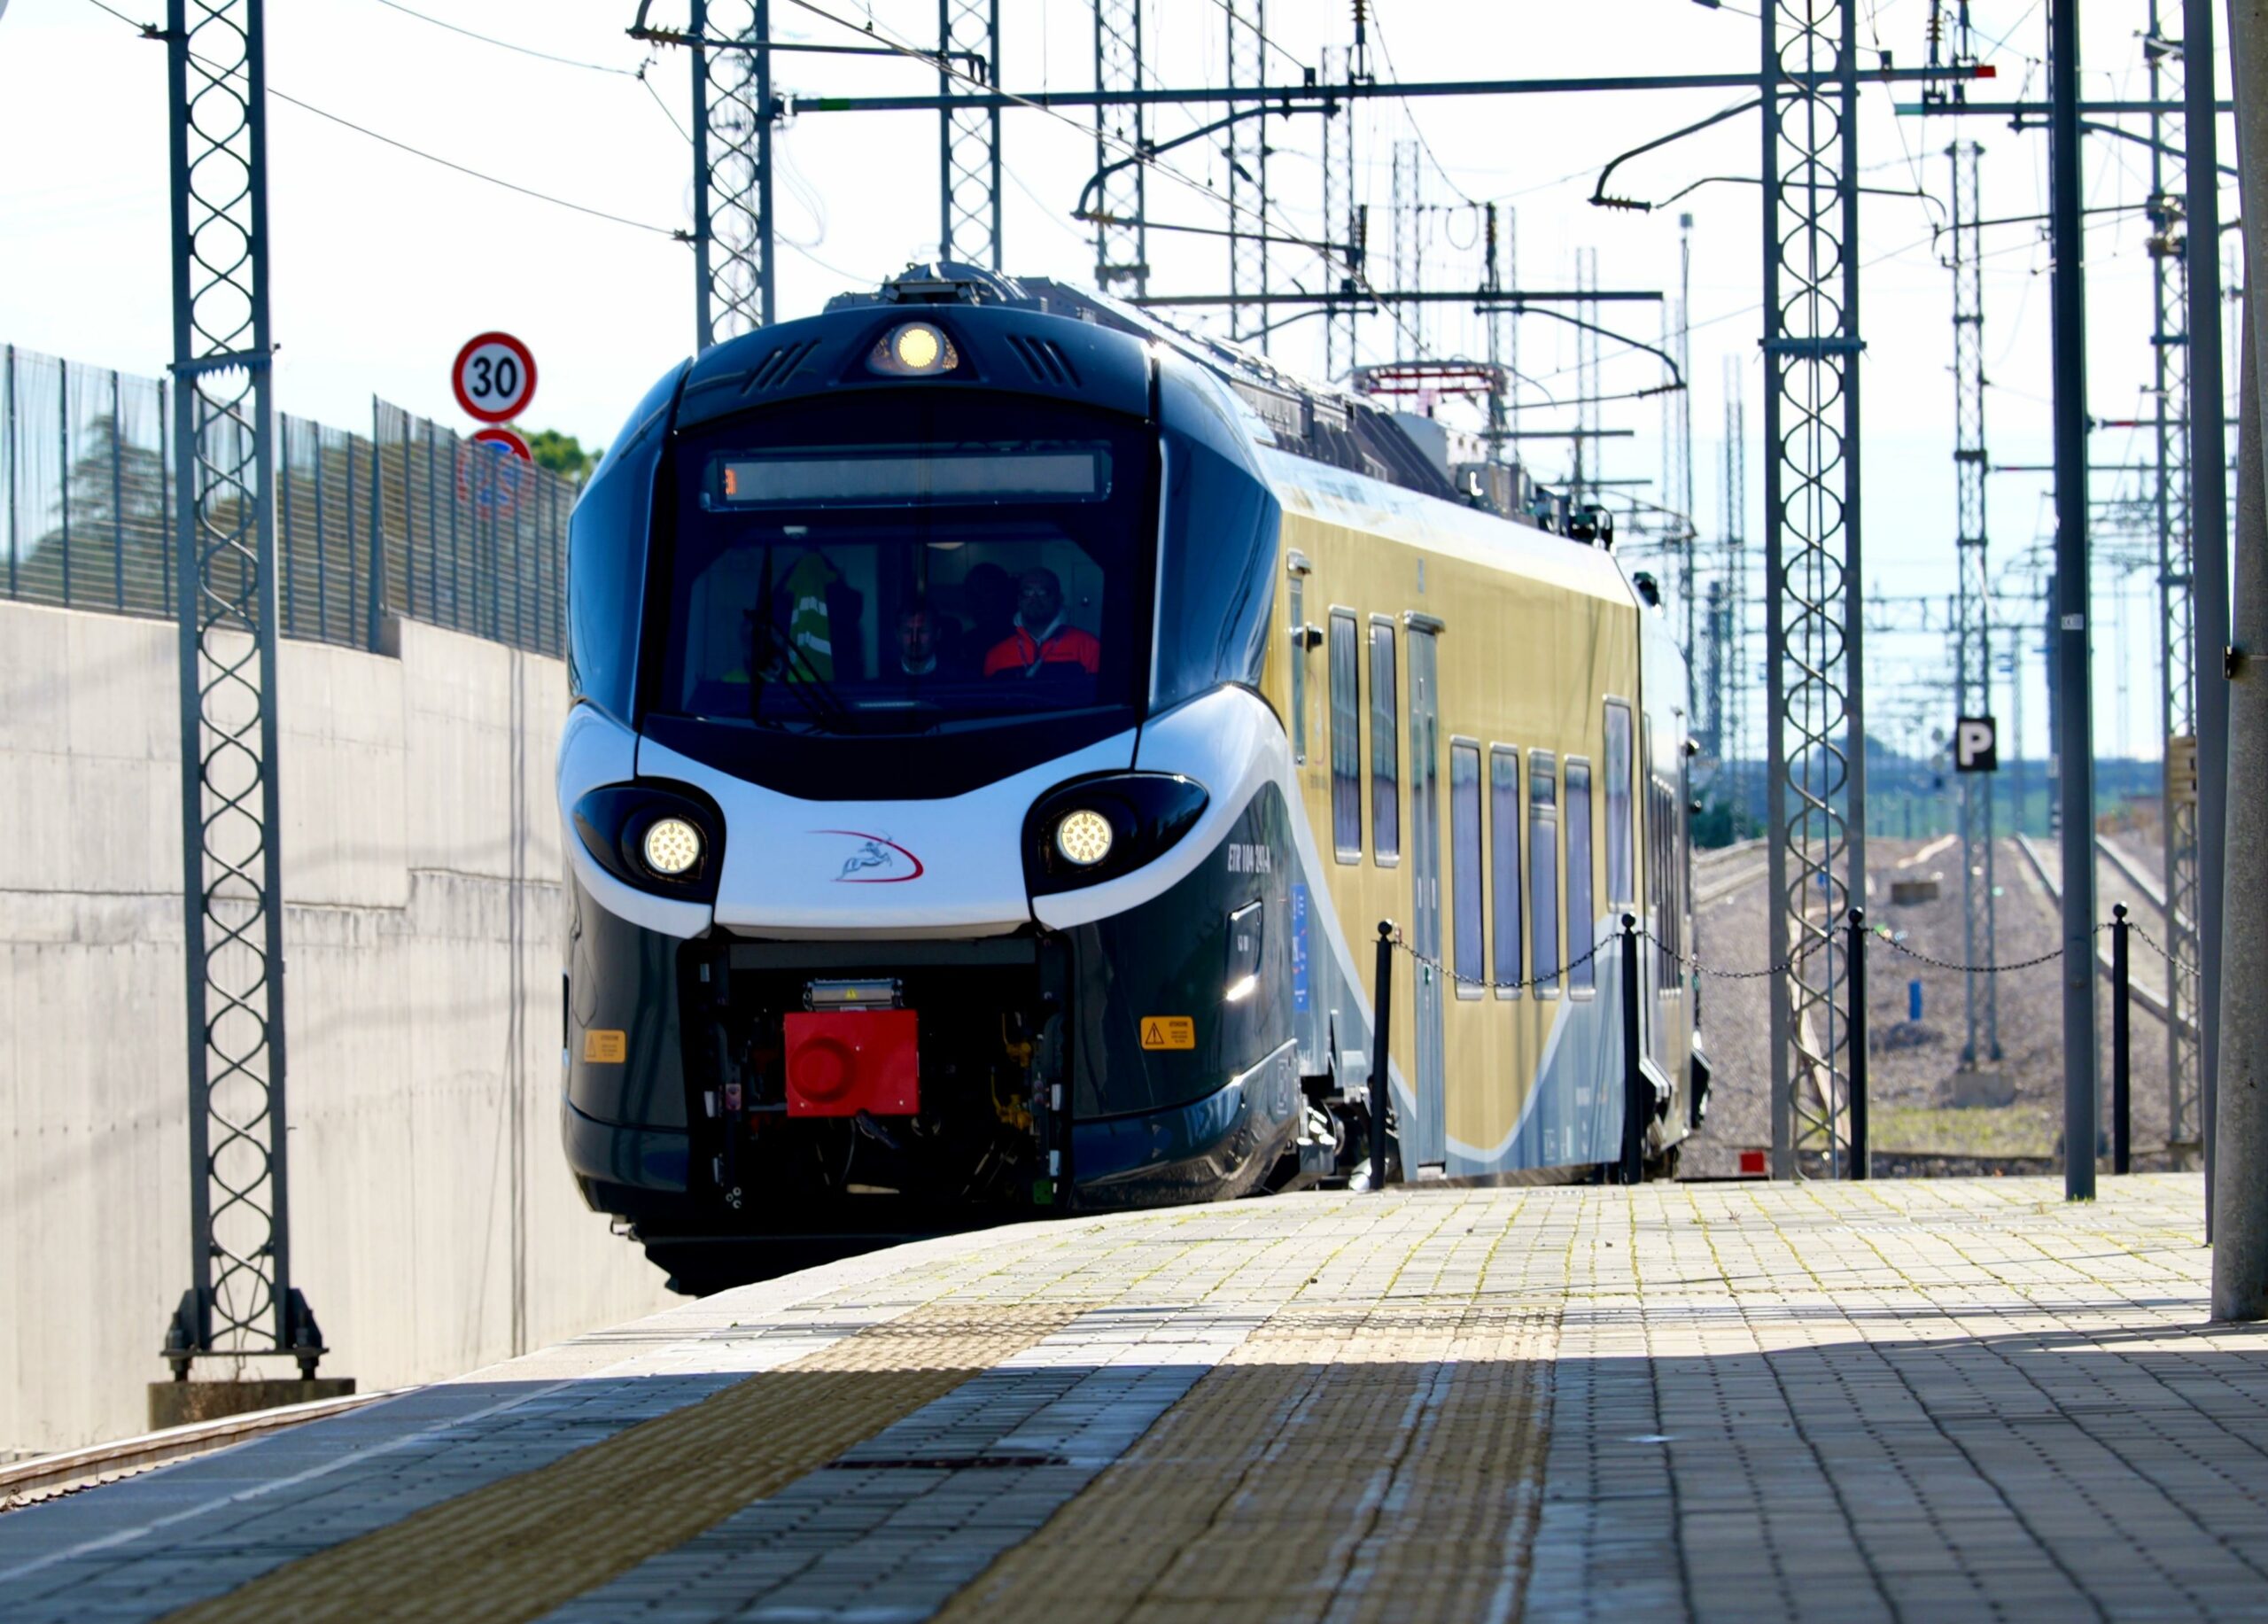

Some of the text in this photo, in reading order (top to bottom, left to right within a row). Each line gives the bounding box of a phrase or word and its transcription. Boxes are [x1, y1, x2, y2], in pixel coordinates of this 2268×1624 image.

[472, 356, 517, 398] 30
[1959, 722, 1993, 766] P
[1228, 843, 1240, 872] ETR
[1242, 844, 1254, 873] 104
